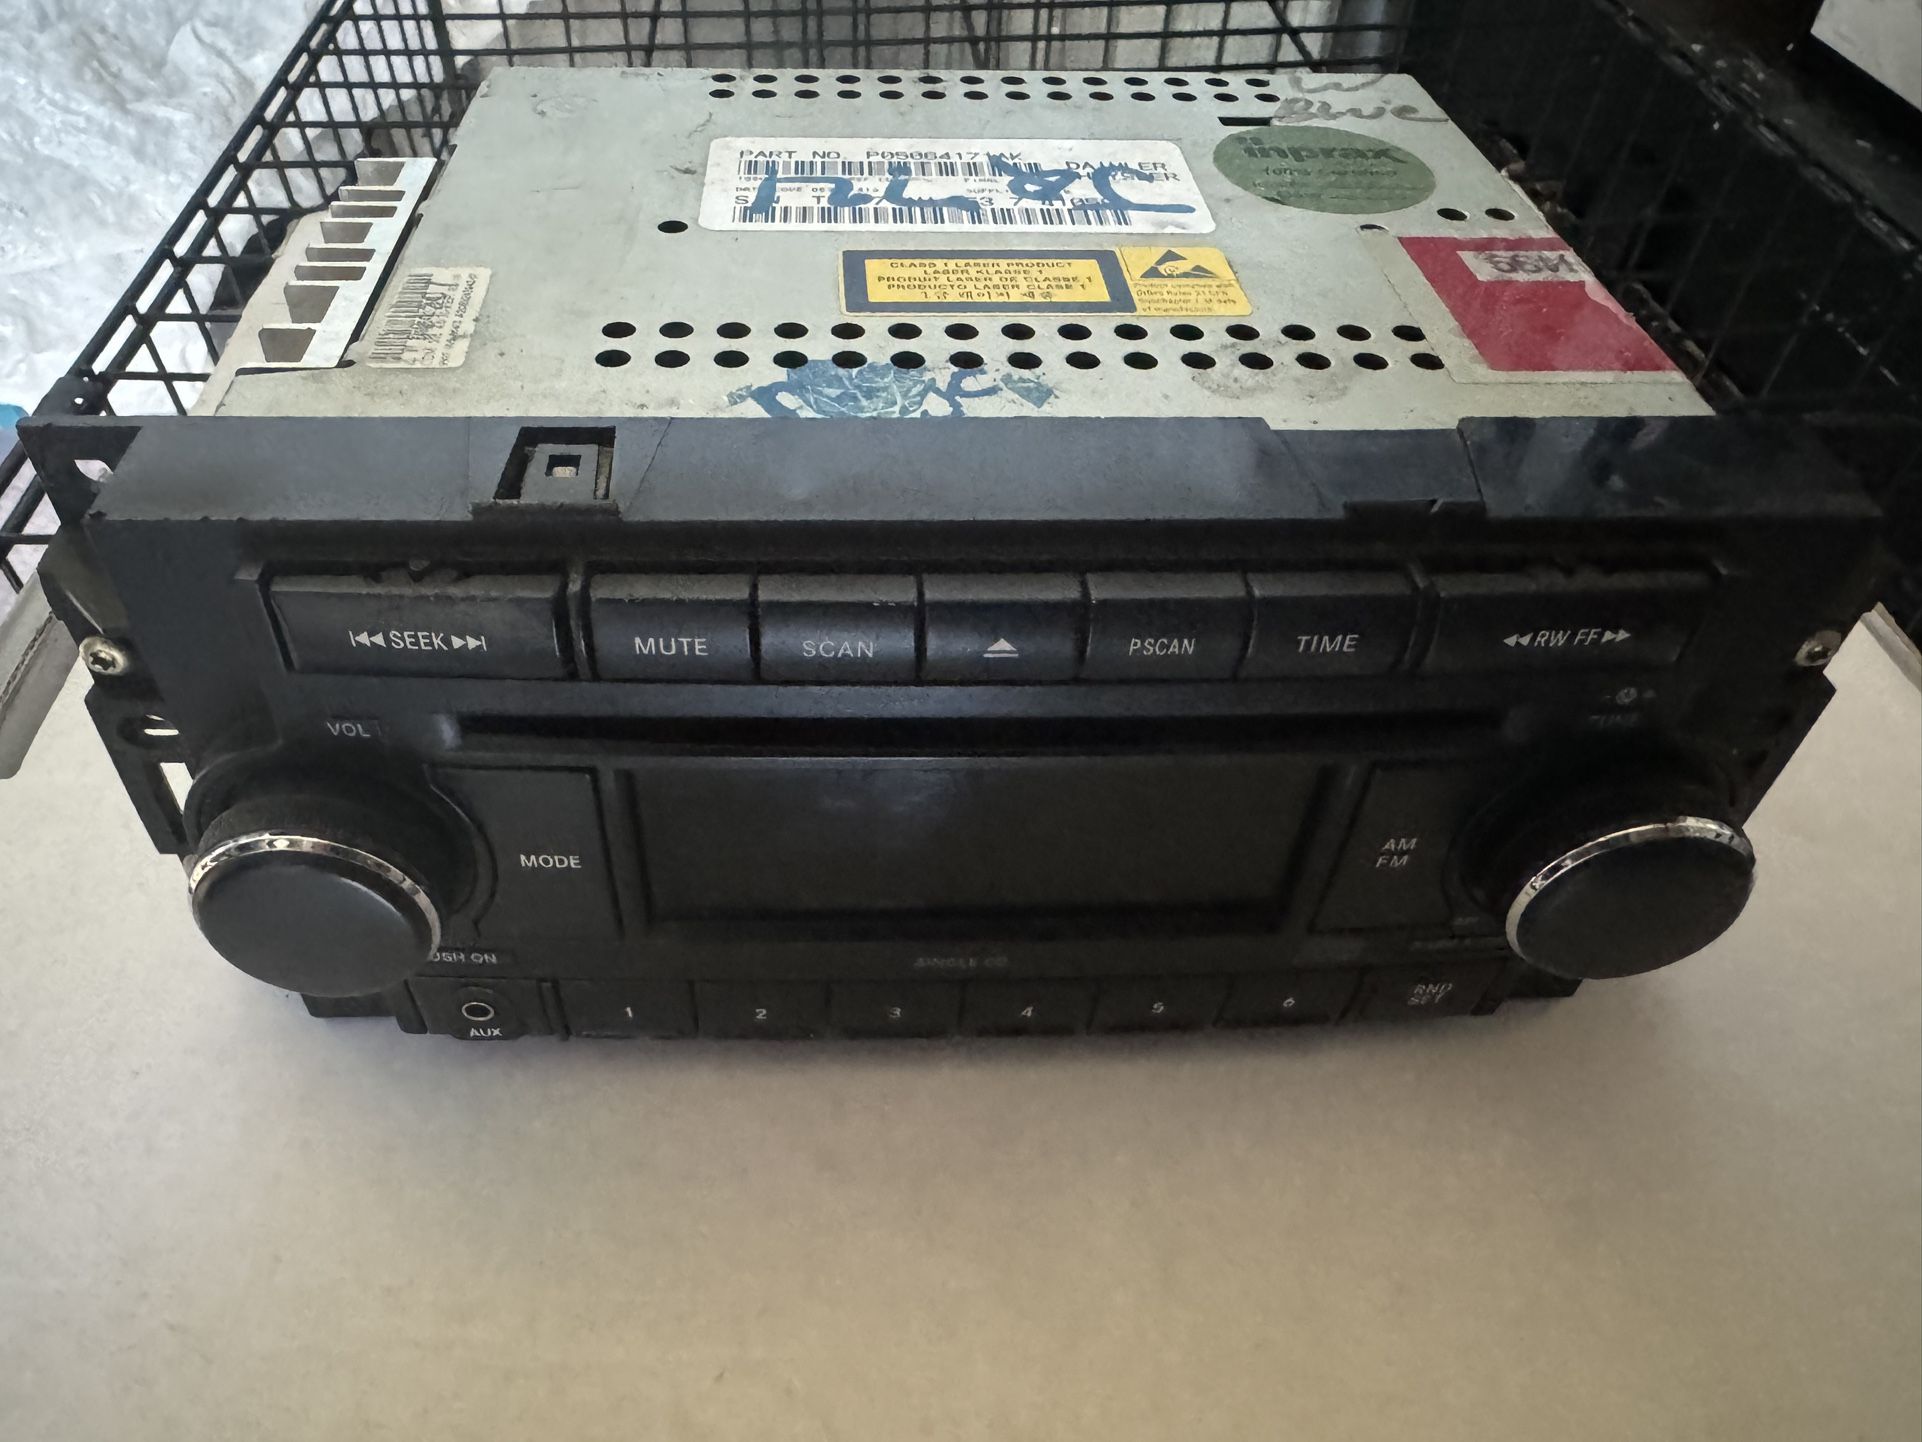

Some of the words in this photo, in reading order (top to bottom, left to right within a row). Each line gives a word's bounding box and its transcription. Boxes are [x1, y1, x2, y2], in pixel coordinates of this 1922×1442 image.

[739, 150, 798, 160] PART
[389, 630, 449, 651] SEEK
[1296, 634, 1359, 653] TIME
[1533, 629, 1571, 647] RW
[1573, 628, 1604, 647] FF
[634, 636, 710, 656] MUTE
[802, 640, 875, 659] SCAN
[1128, 637, 1196, 656] PSCAN
[326, 721, 372, 738] VOL
[1382, 837, 1418, 850] AM
[519, 854, 582, 869] MODE
[1375, 855, 1409, 868] FM
[470, 952, 497, 964] ON
[625, 1006, 633, 1018] 1
[755, 1008, 767, 1020] 2
[890, 1006, 901, 1019] 3
[1021, 1006, 1034, 1018] 4
[469, 1027, 502, 1037] AUX
